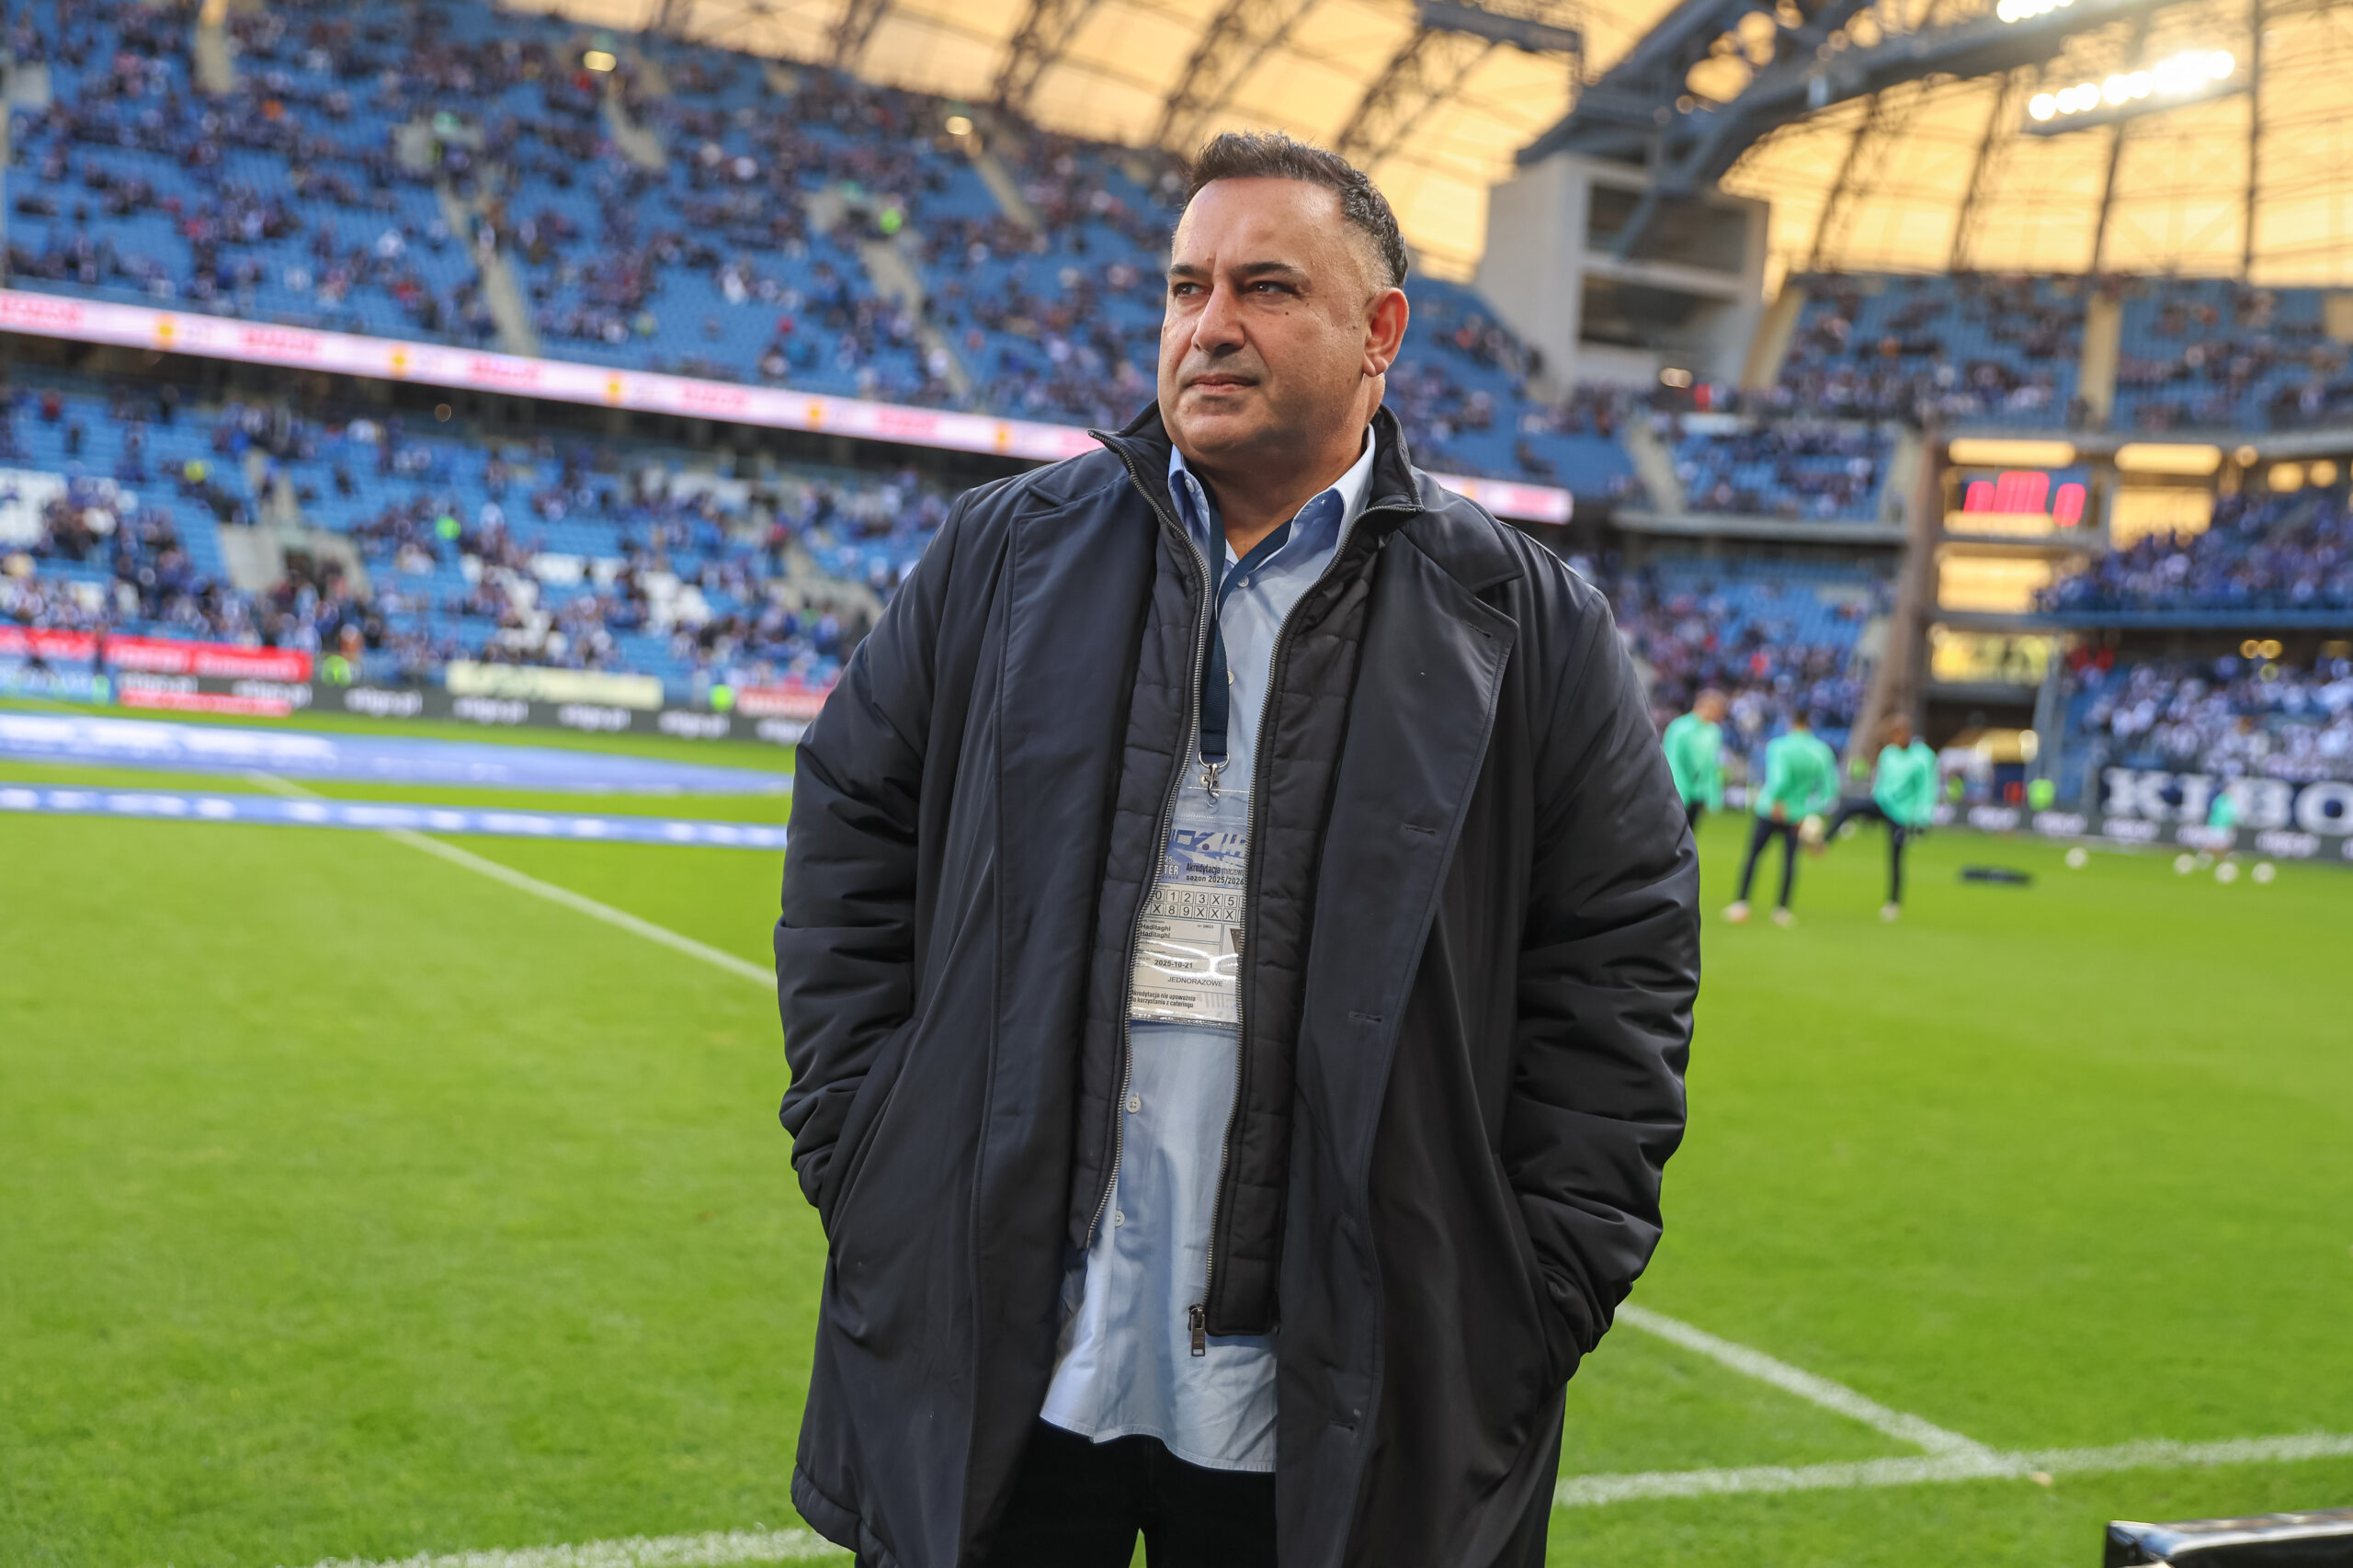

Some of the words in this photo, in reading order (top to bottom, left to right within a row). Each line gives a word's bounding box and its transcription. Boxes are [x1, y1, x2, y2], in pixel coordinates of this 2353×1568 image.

[1186, 862, 1221, 876] Akredytacja
[1208, 875, 1245, 886] 2025/2026
[1171, 892, 1176, 902] 1
[1184, 892, 1191, 903] 2
[1199, 894, 1206, 903] 3
[1211, 895, 1221, 905] X
[1227, 896, 1234, 906] 5
[1168, 905, 1176, 915] 8
[1183, 906, 1190, 916] 9
[1195, 908, 1204, 917] X
[1211, 909, 1220, 918] X
[1225, 910, 1233, 920] X
[1141, 924, 1171, 933] Haditaghi
[1154, 959, 1193, 969] 2025-10-21
[1167, 976, 1223, 987] JEDNORAZOWE
